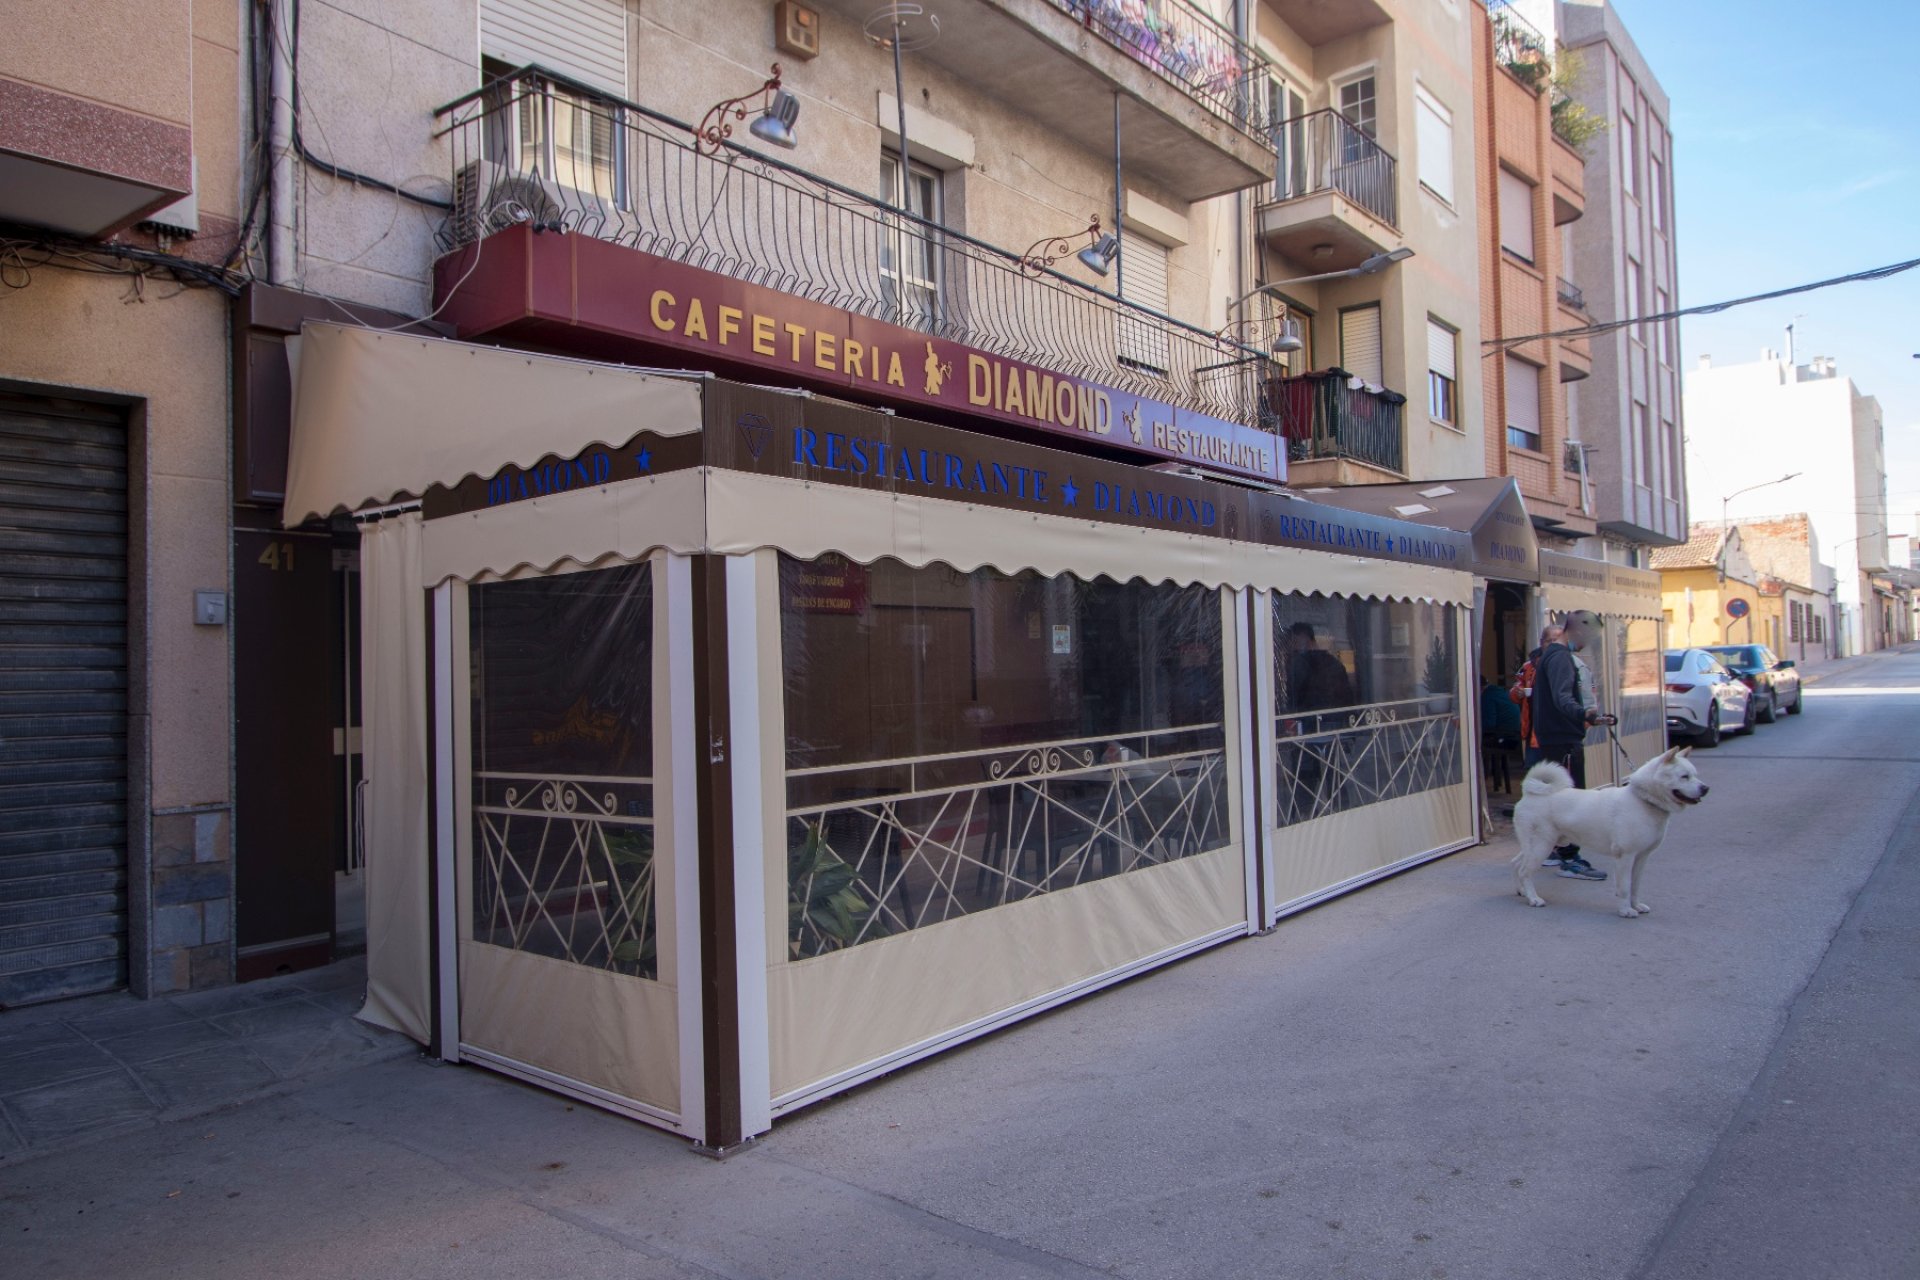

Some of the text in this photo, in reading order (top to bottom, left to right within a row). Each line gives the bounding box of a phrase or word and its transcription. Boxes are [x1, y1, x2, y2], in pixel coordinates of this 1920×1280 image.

[650, 290, 905, 387] CAFETERIA
[968, 353, 1112, 436] DIAMOND
[1152, 421, 1269, 473] RESTAURANTE
[488, 452, 610, 506] DIAMOND
[792, 426, 1216, 528] RESTAURANTE DIAMOND
[258, 541, 294, 571] 41
[1279, 514, 1456, 562] RESTAURANTE DIAMOND
